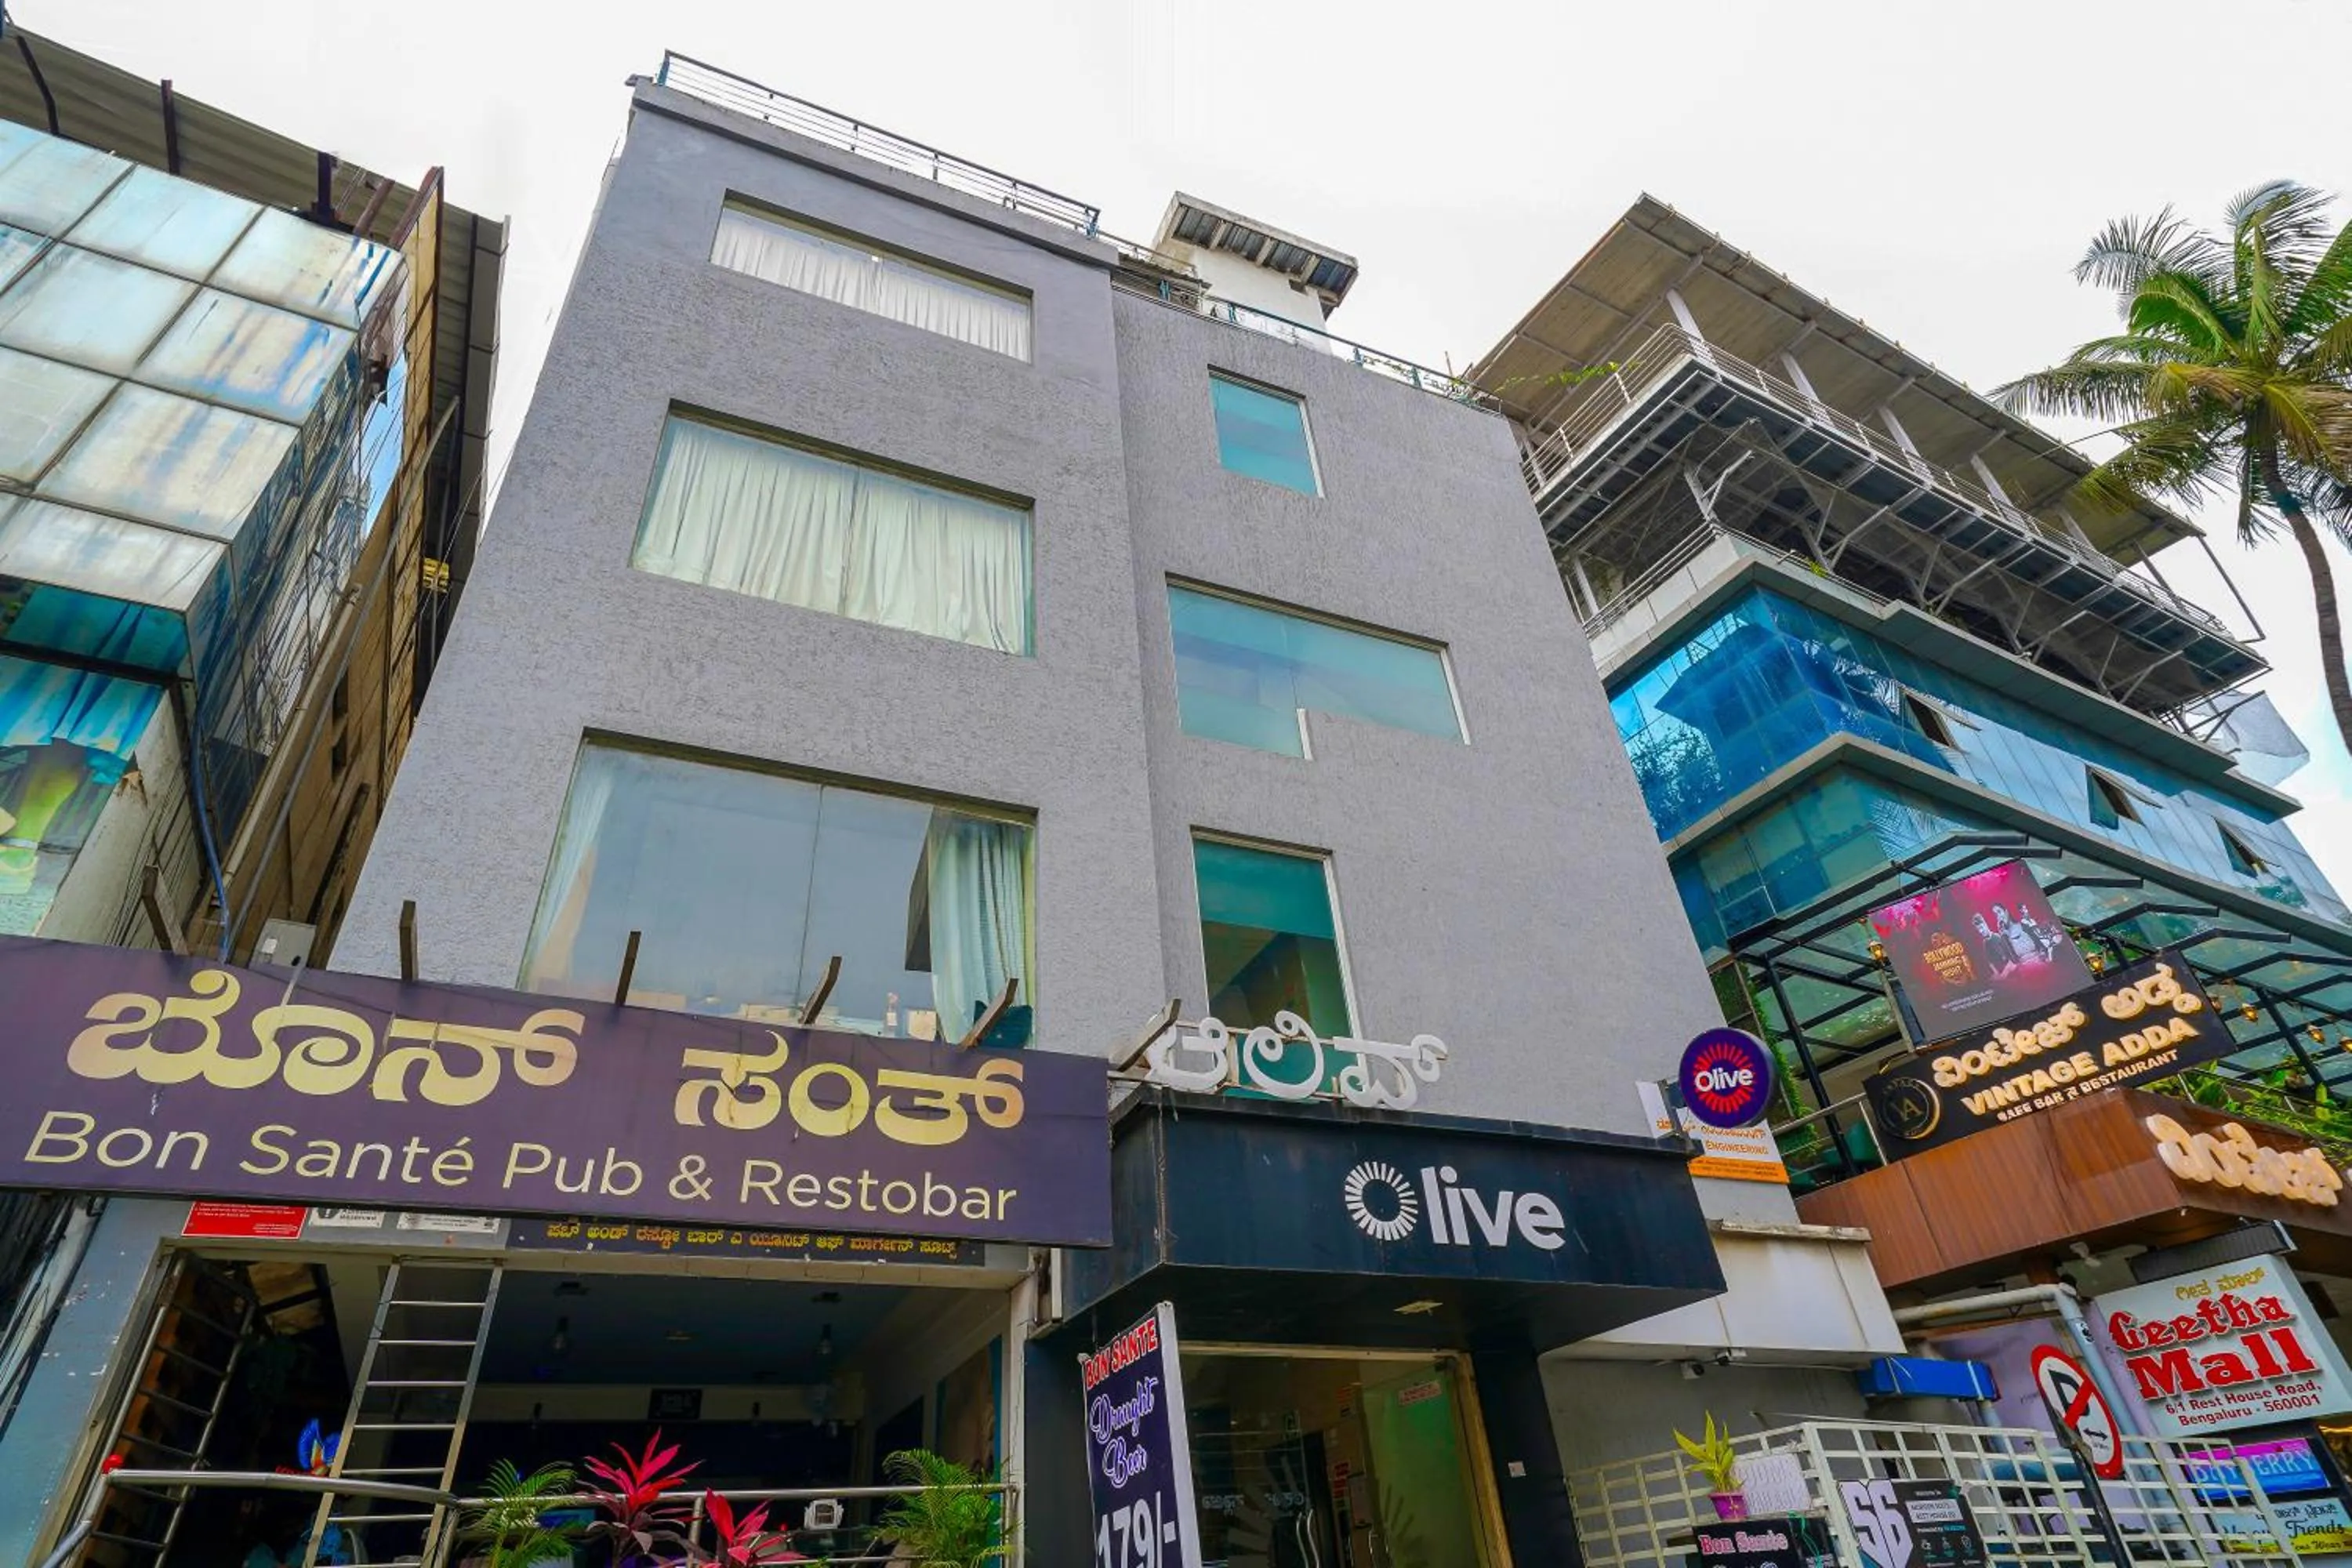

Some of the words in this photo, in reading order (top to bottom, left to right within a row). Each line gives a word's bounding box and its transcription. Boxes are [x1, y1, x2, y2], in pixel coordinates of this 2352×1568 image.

[1694, 1067, 1754, 1092] Olive
[1962, 1051, 2100, 1116] VINTAGE
[2103, 1018, 2198, 1068] ADDA
[2037, 1090, 2065, 1111] BAR
[2082, 1050, 2179, 1095] RESTAURANT
[24, 1110, 210, 1171] Bon
[239, 1123, 475, 1187] Santé
[502, 1141, 644, 1196] Pub
[669, 1153, 714, 1202] &
[739, 1159, 1018, 1221] Restobar
[1344, 1160, 1566, 1250] Olive
[1085, 1346, 1111, 1390] BON
[1111, 1316, 1159, 1373] SANTE
[2108, 1293, 2292, 1351] Geetha
[2125, 1327, 2317, 1400] Mall
[1090, 1377, 1159, 1445] Draught
[2166, 1402, 2186, 1415] 6/1
[2190, 1396, 2223, 1411] Rest
[2227, 1389, 2272, 1404] House
[2276, 1380, 2322, 1396] Road,
[2178, 1406, 2252, 1427] Bengaluru
[2263, 1394, 2321, 1412] 560001
[1102, 1436, 1147, 1488] Beer
[1098, 1490, 1177, 1568] 179/-
[1699, 1534, 1736, 1555] Bon
